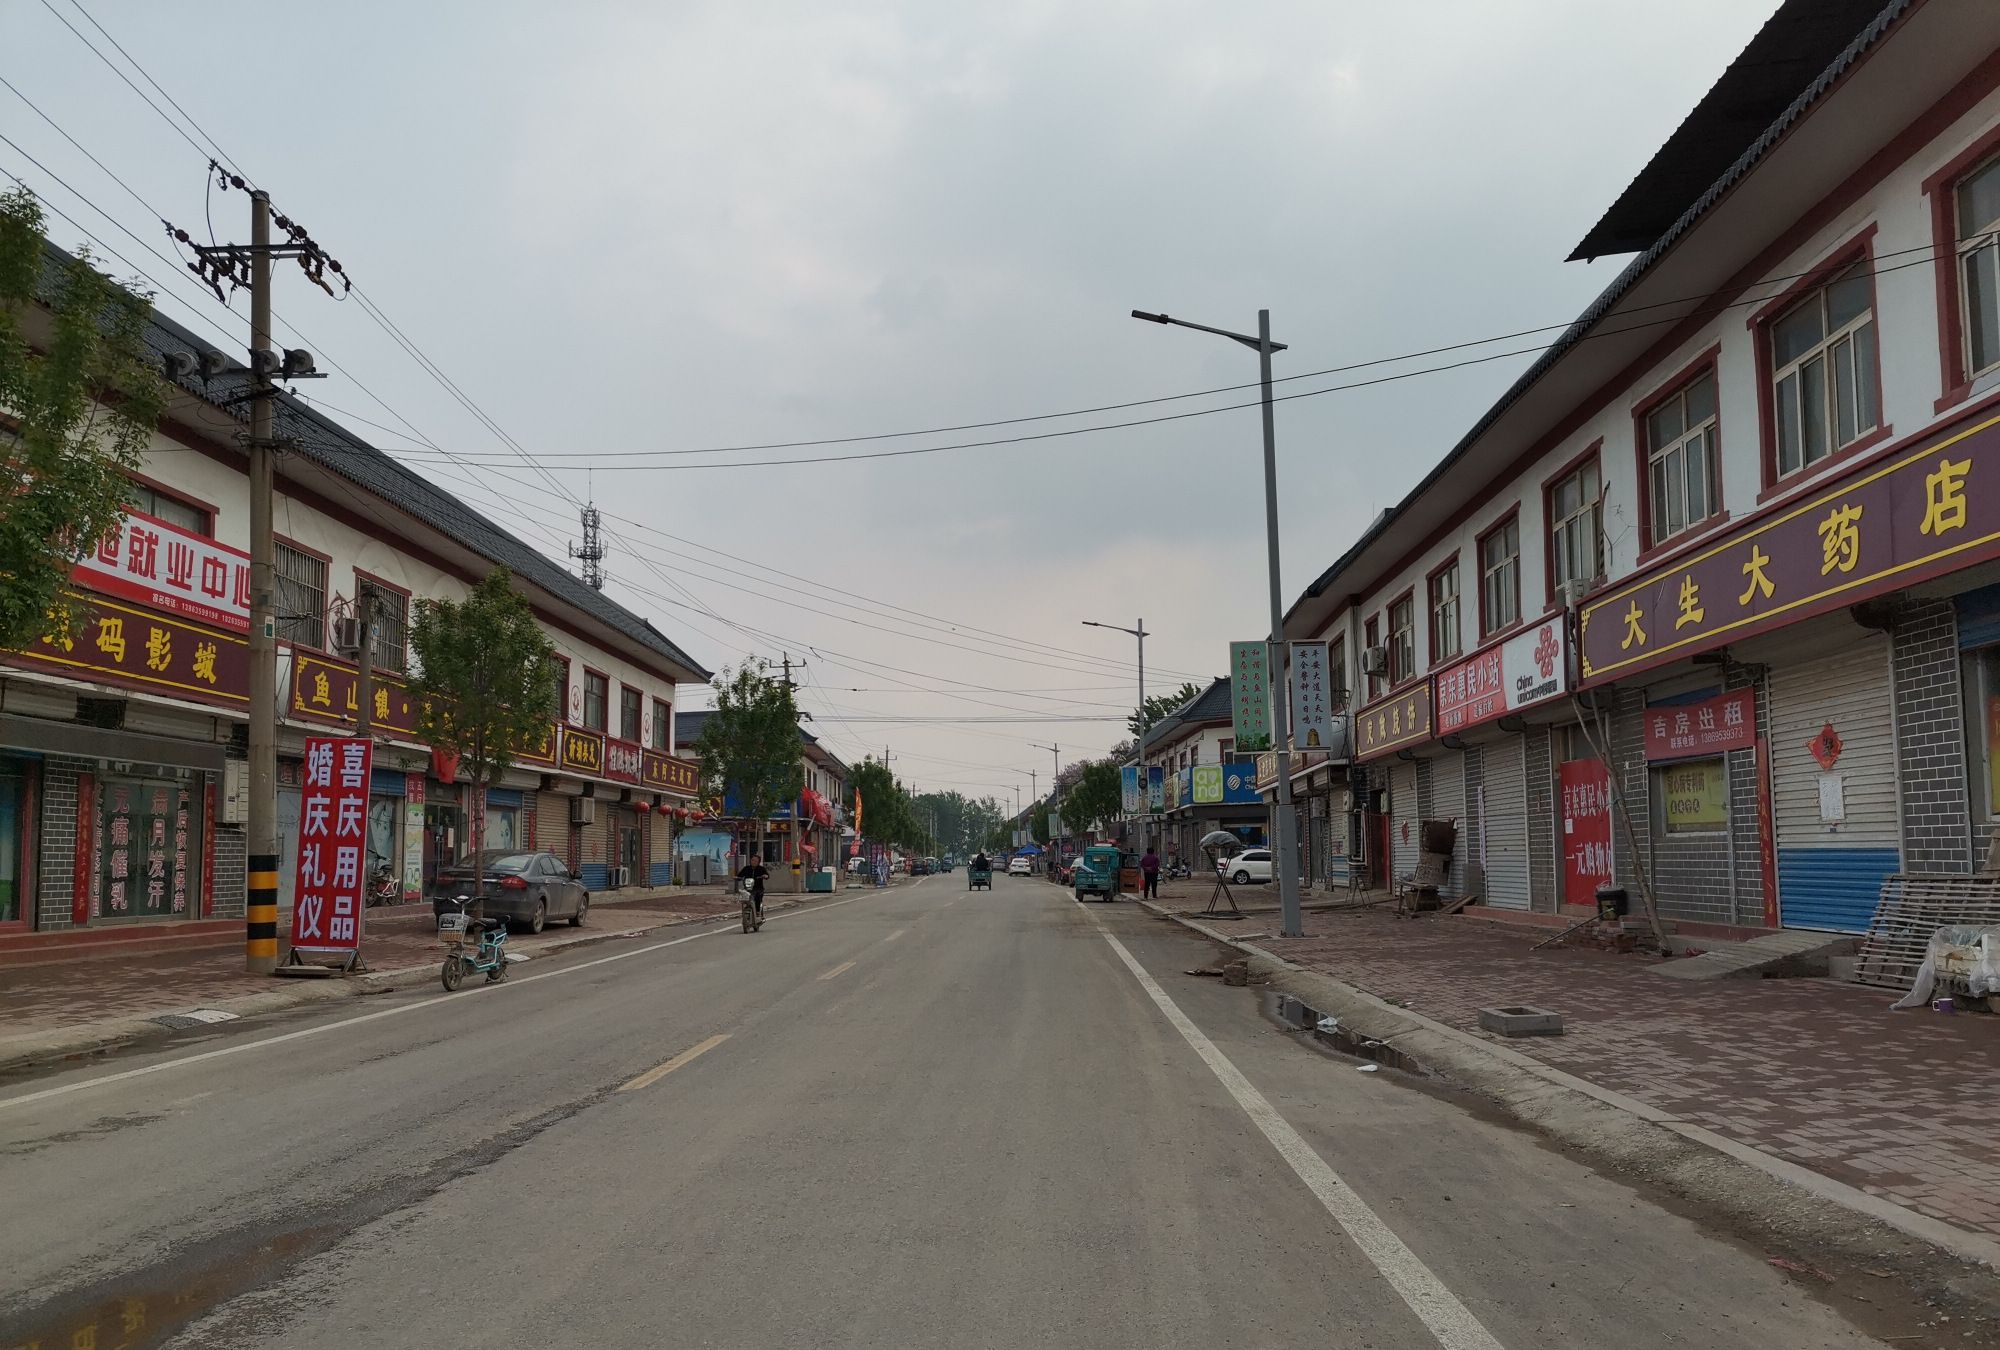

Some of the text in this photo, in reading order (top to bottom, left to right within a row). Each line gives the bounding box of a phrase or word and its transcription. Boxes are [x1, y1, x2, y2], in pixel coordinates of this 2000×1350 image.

[1622, 458, 1972, 651] 大生大药店
[1299, 649, 1311, 725] 安全警钟日日鸣
[1311, 649, 1324, 725] 平安大道天天行
[1438, 655, 1500, 709] 京东惠民小站
[1516, 673, 1533, 692] China
[1652, 700, 1744, 738] 吉房出租
[110, 785, 130, 910] 无痛催乳
[297, 741, 333, 940] 婚庆礼仪
[329, 742, 366, 941] 喜庆用品
